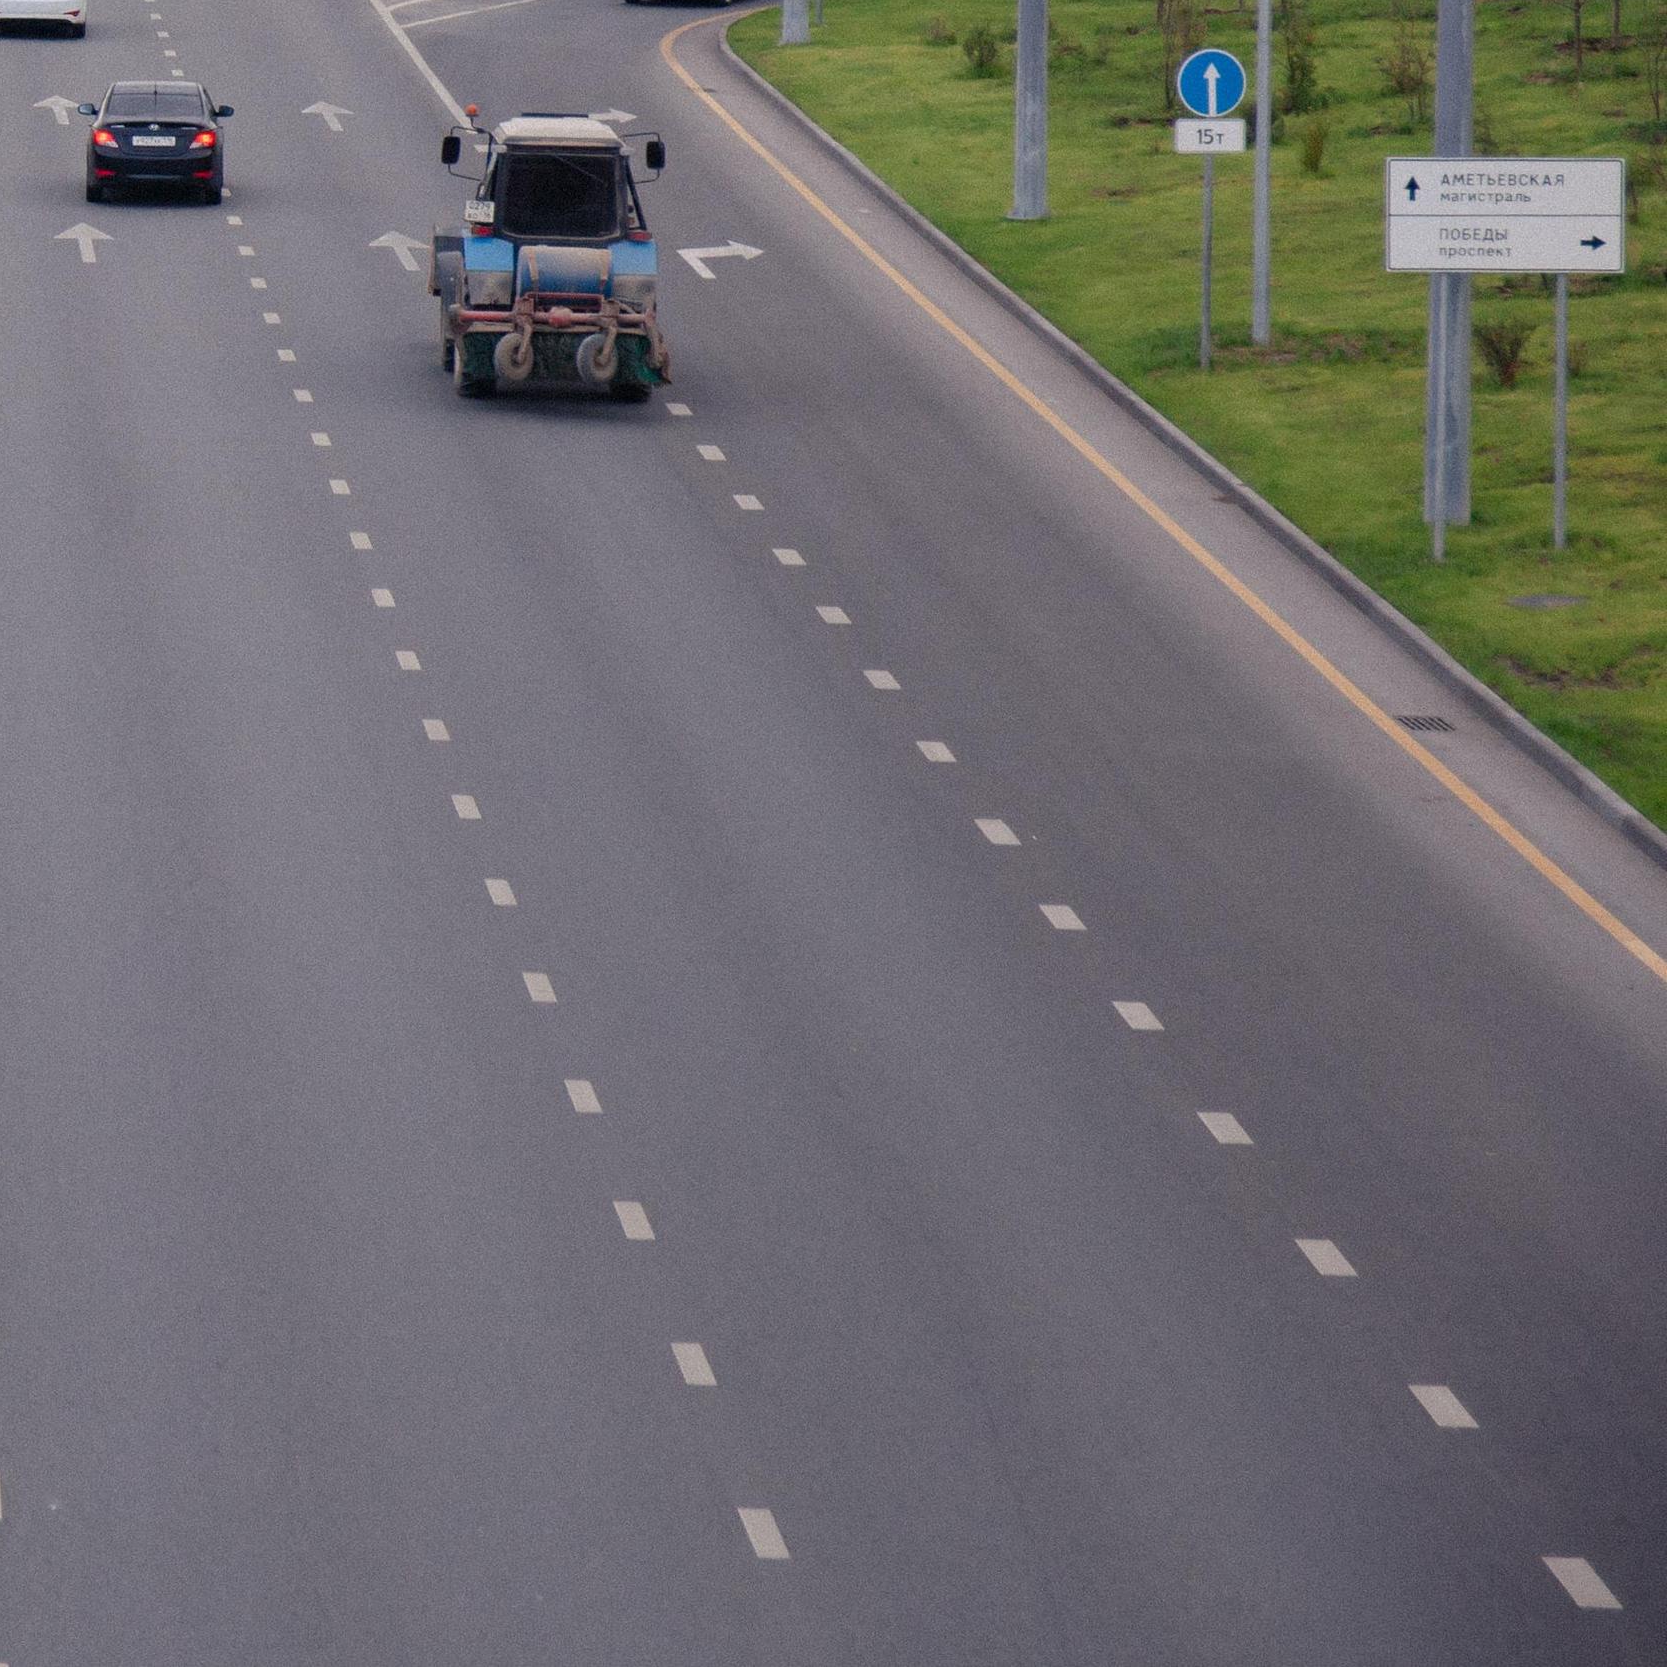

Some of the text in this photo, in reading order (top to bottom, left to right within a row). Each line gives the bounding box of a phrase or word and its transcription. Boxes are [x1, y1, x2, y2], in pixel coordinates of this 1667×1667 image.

[1441, 173, 1565, 186] АМЕТЬЕВСКАЯ
[1440, 192, 1532, 204] магистраль
[1439, 228, 1508, 242] ПОБЕДЫ
[1439, 246, 1512, 259] проспект
